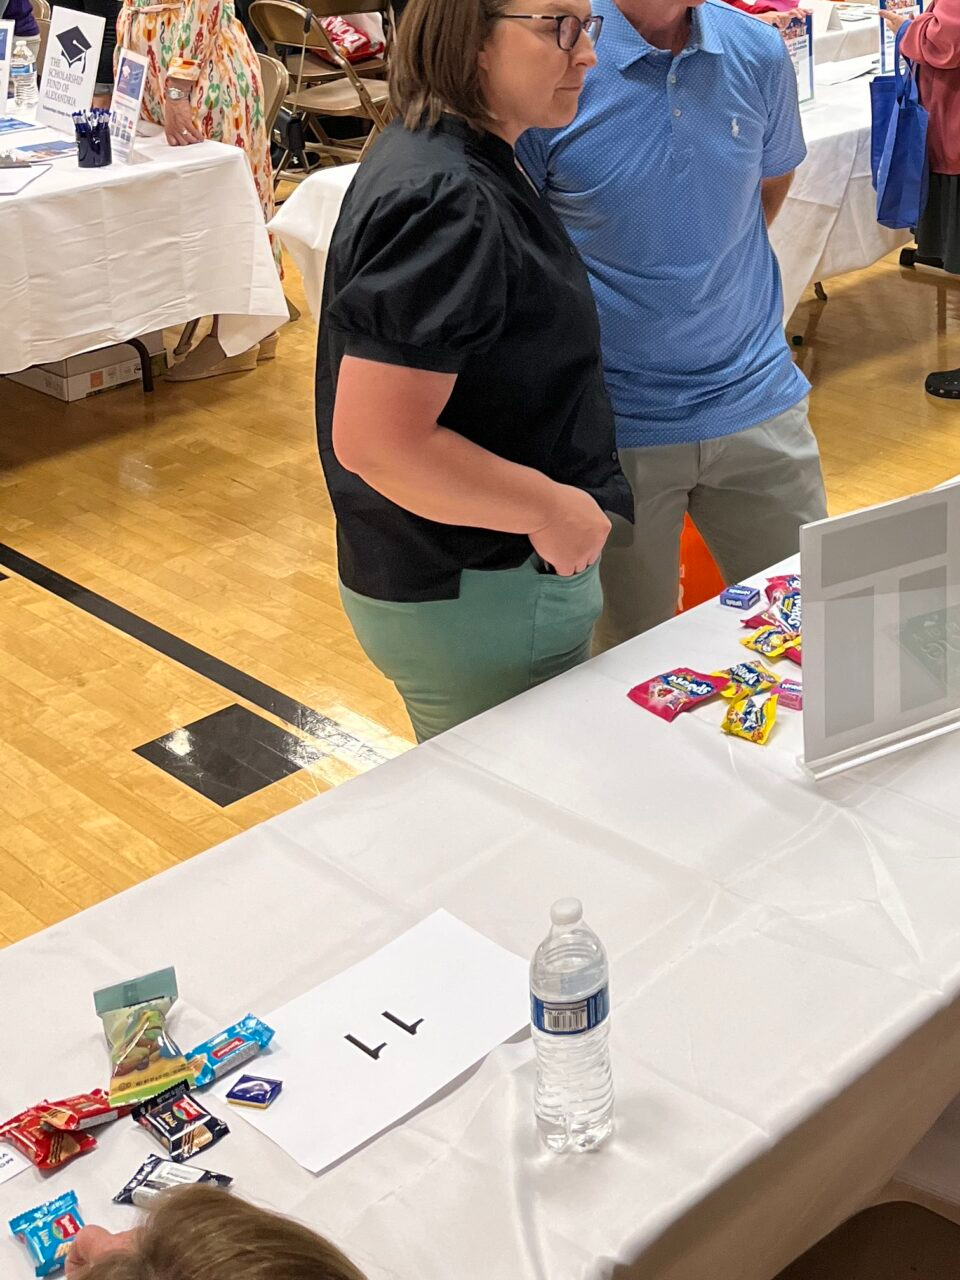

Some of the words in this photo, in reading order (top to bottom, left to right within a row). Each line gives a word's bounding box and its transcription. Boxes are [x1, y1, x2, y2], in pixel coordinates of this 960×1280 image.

[50, 56, 61, 68] THE
[46, 78, 61, 91] FUND
[62, 83, 70, 94] OF
[48, 67, 84, 86] SCHOLARSHIP
[45, 88, 77, 108] ALEXANDRIA
[667, 675, 712, 695] Nerds
[344, 1010, 424, 1061] 11
